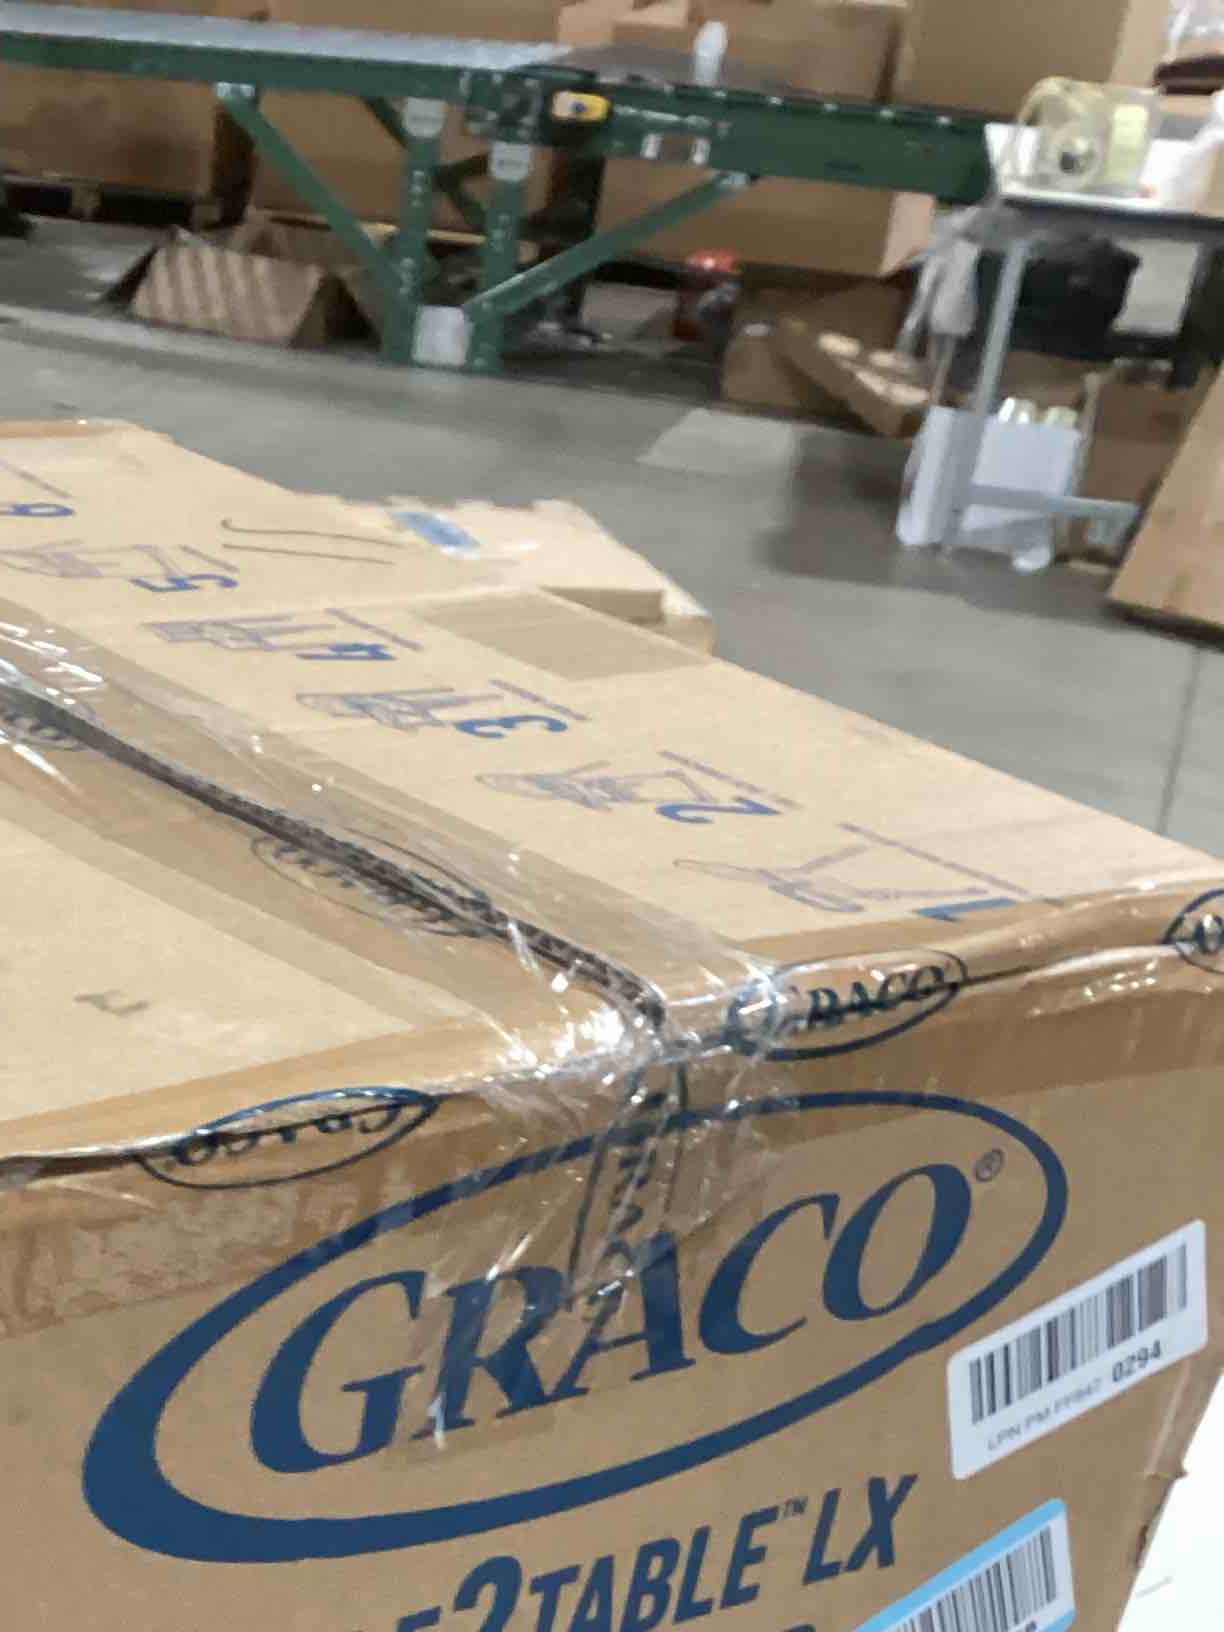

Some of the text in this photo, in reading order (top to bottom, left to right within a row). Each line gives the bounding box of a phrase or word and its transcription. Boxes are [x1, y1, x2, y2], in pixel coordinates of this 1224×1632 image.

[454, 714, 568, 739] 3
[655, 796, 783, 825] 2
[1111, 1338, 1163, 1383] 0294
[802, 1473, 919, 1587] LX
